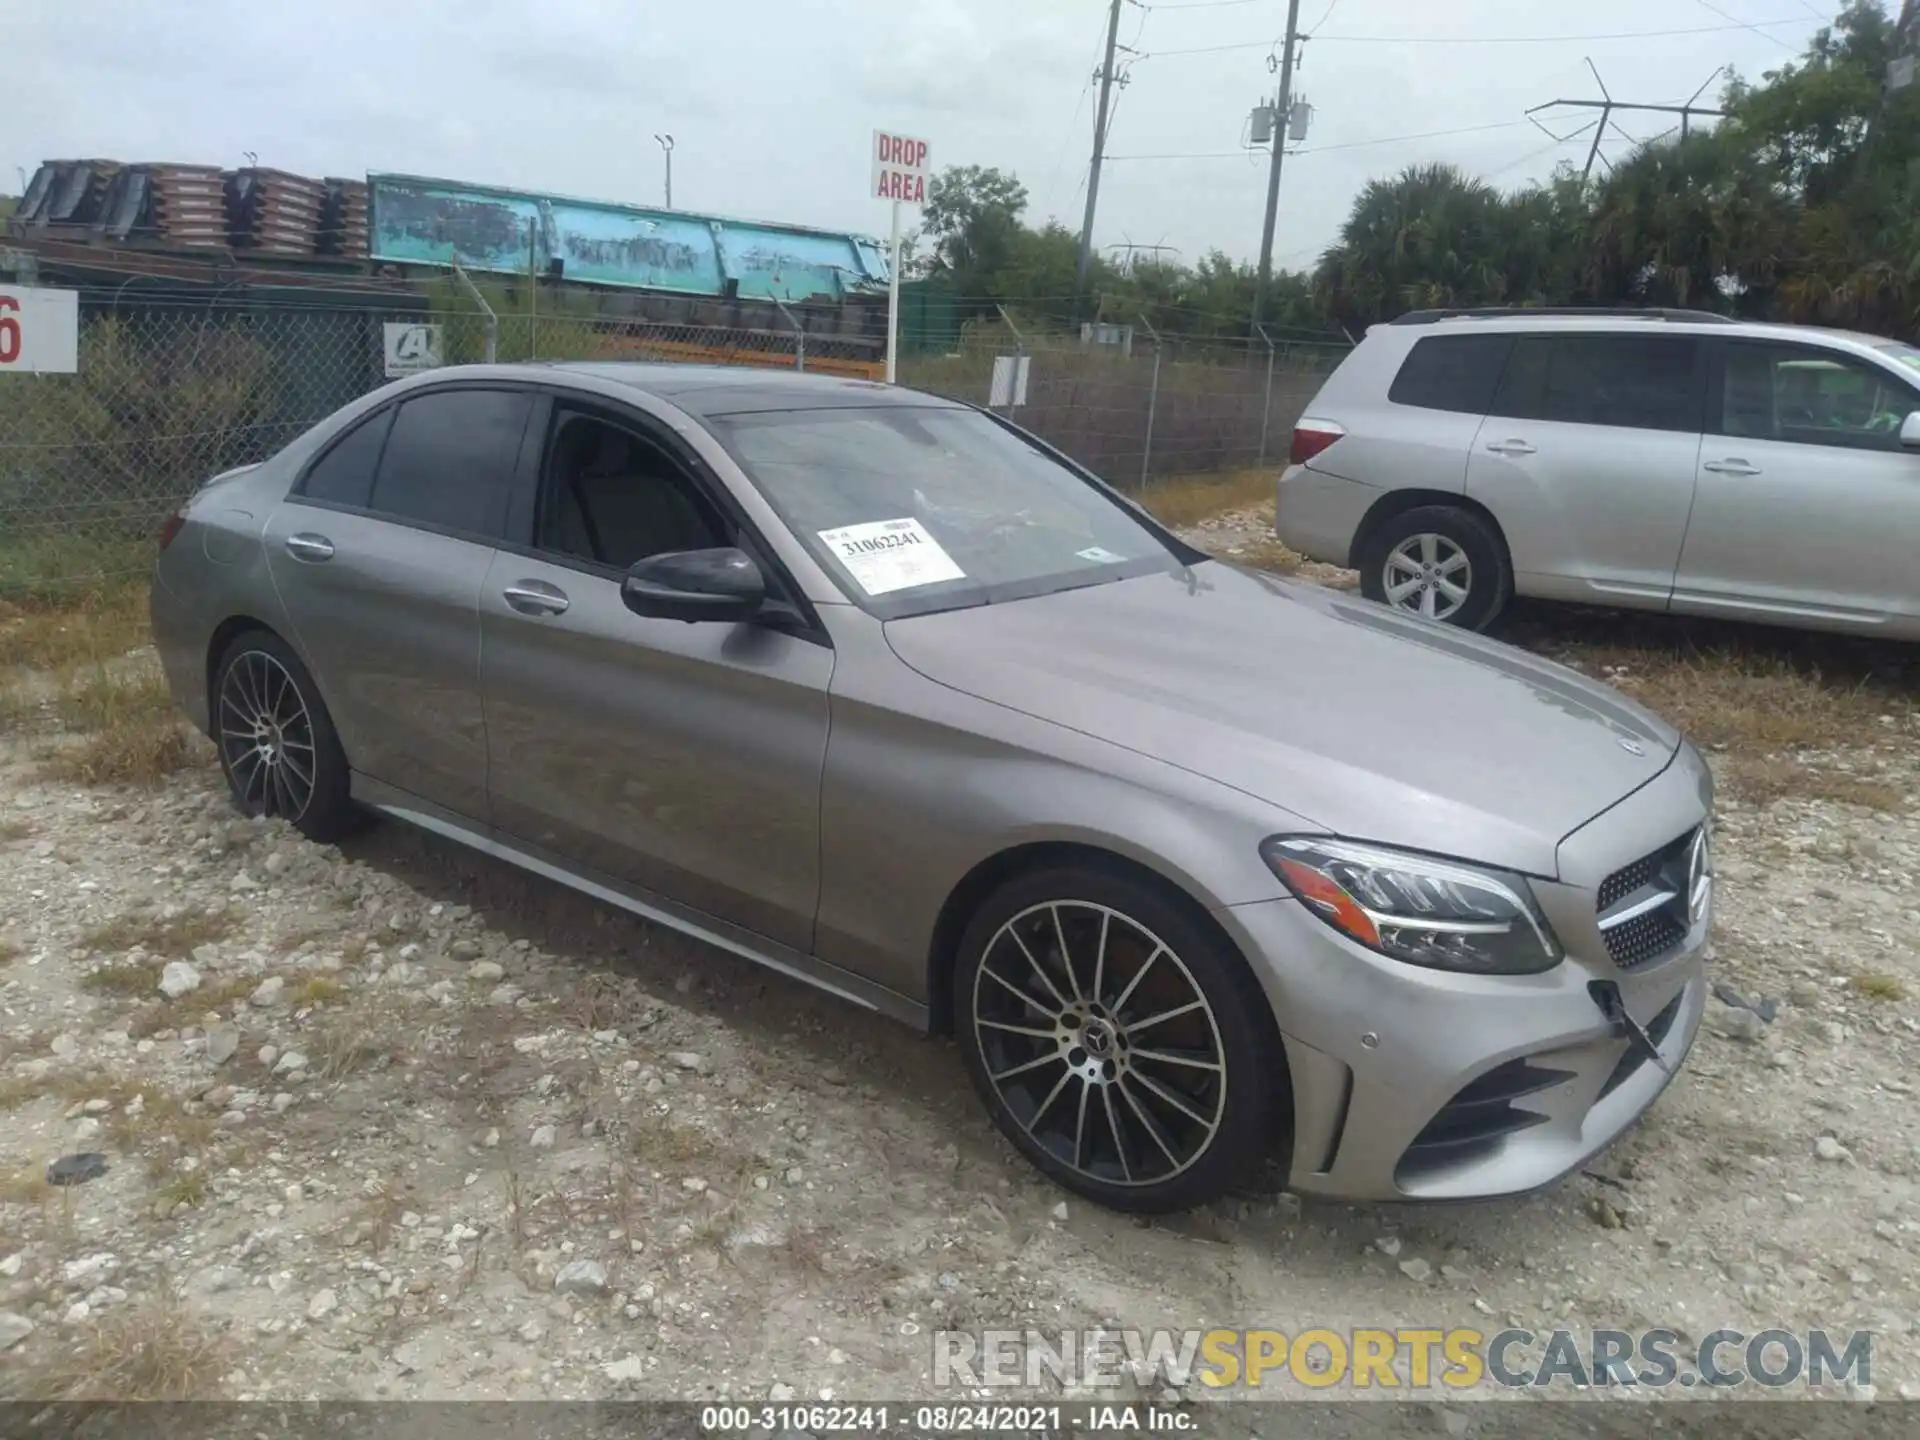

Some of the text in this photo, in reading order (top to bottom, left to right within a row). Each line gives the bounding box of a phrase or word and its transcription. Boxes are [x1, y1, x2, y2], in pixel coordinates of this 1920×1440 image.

[879, 133, 927, 168] DROP
[878, 170, 925, 202] AREA
[0, 295, 21, 363] 6
[841, 532, 922, 556] 31062241
